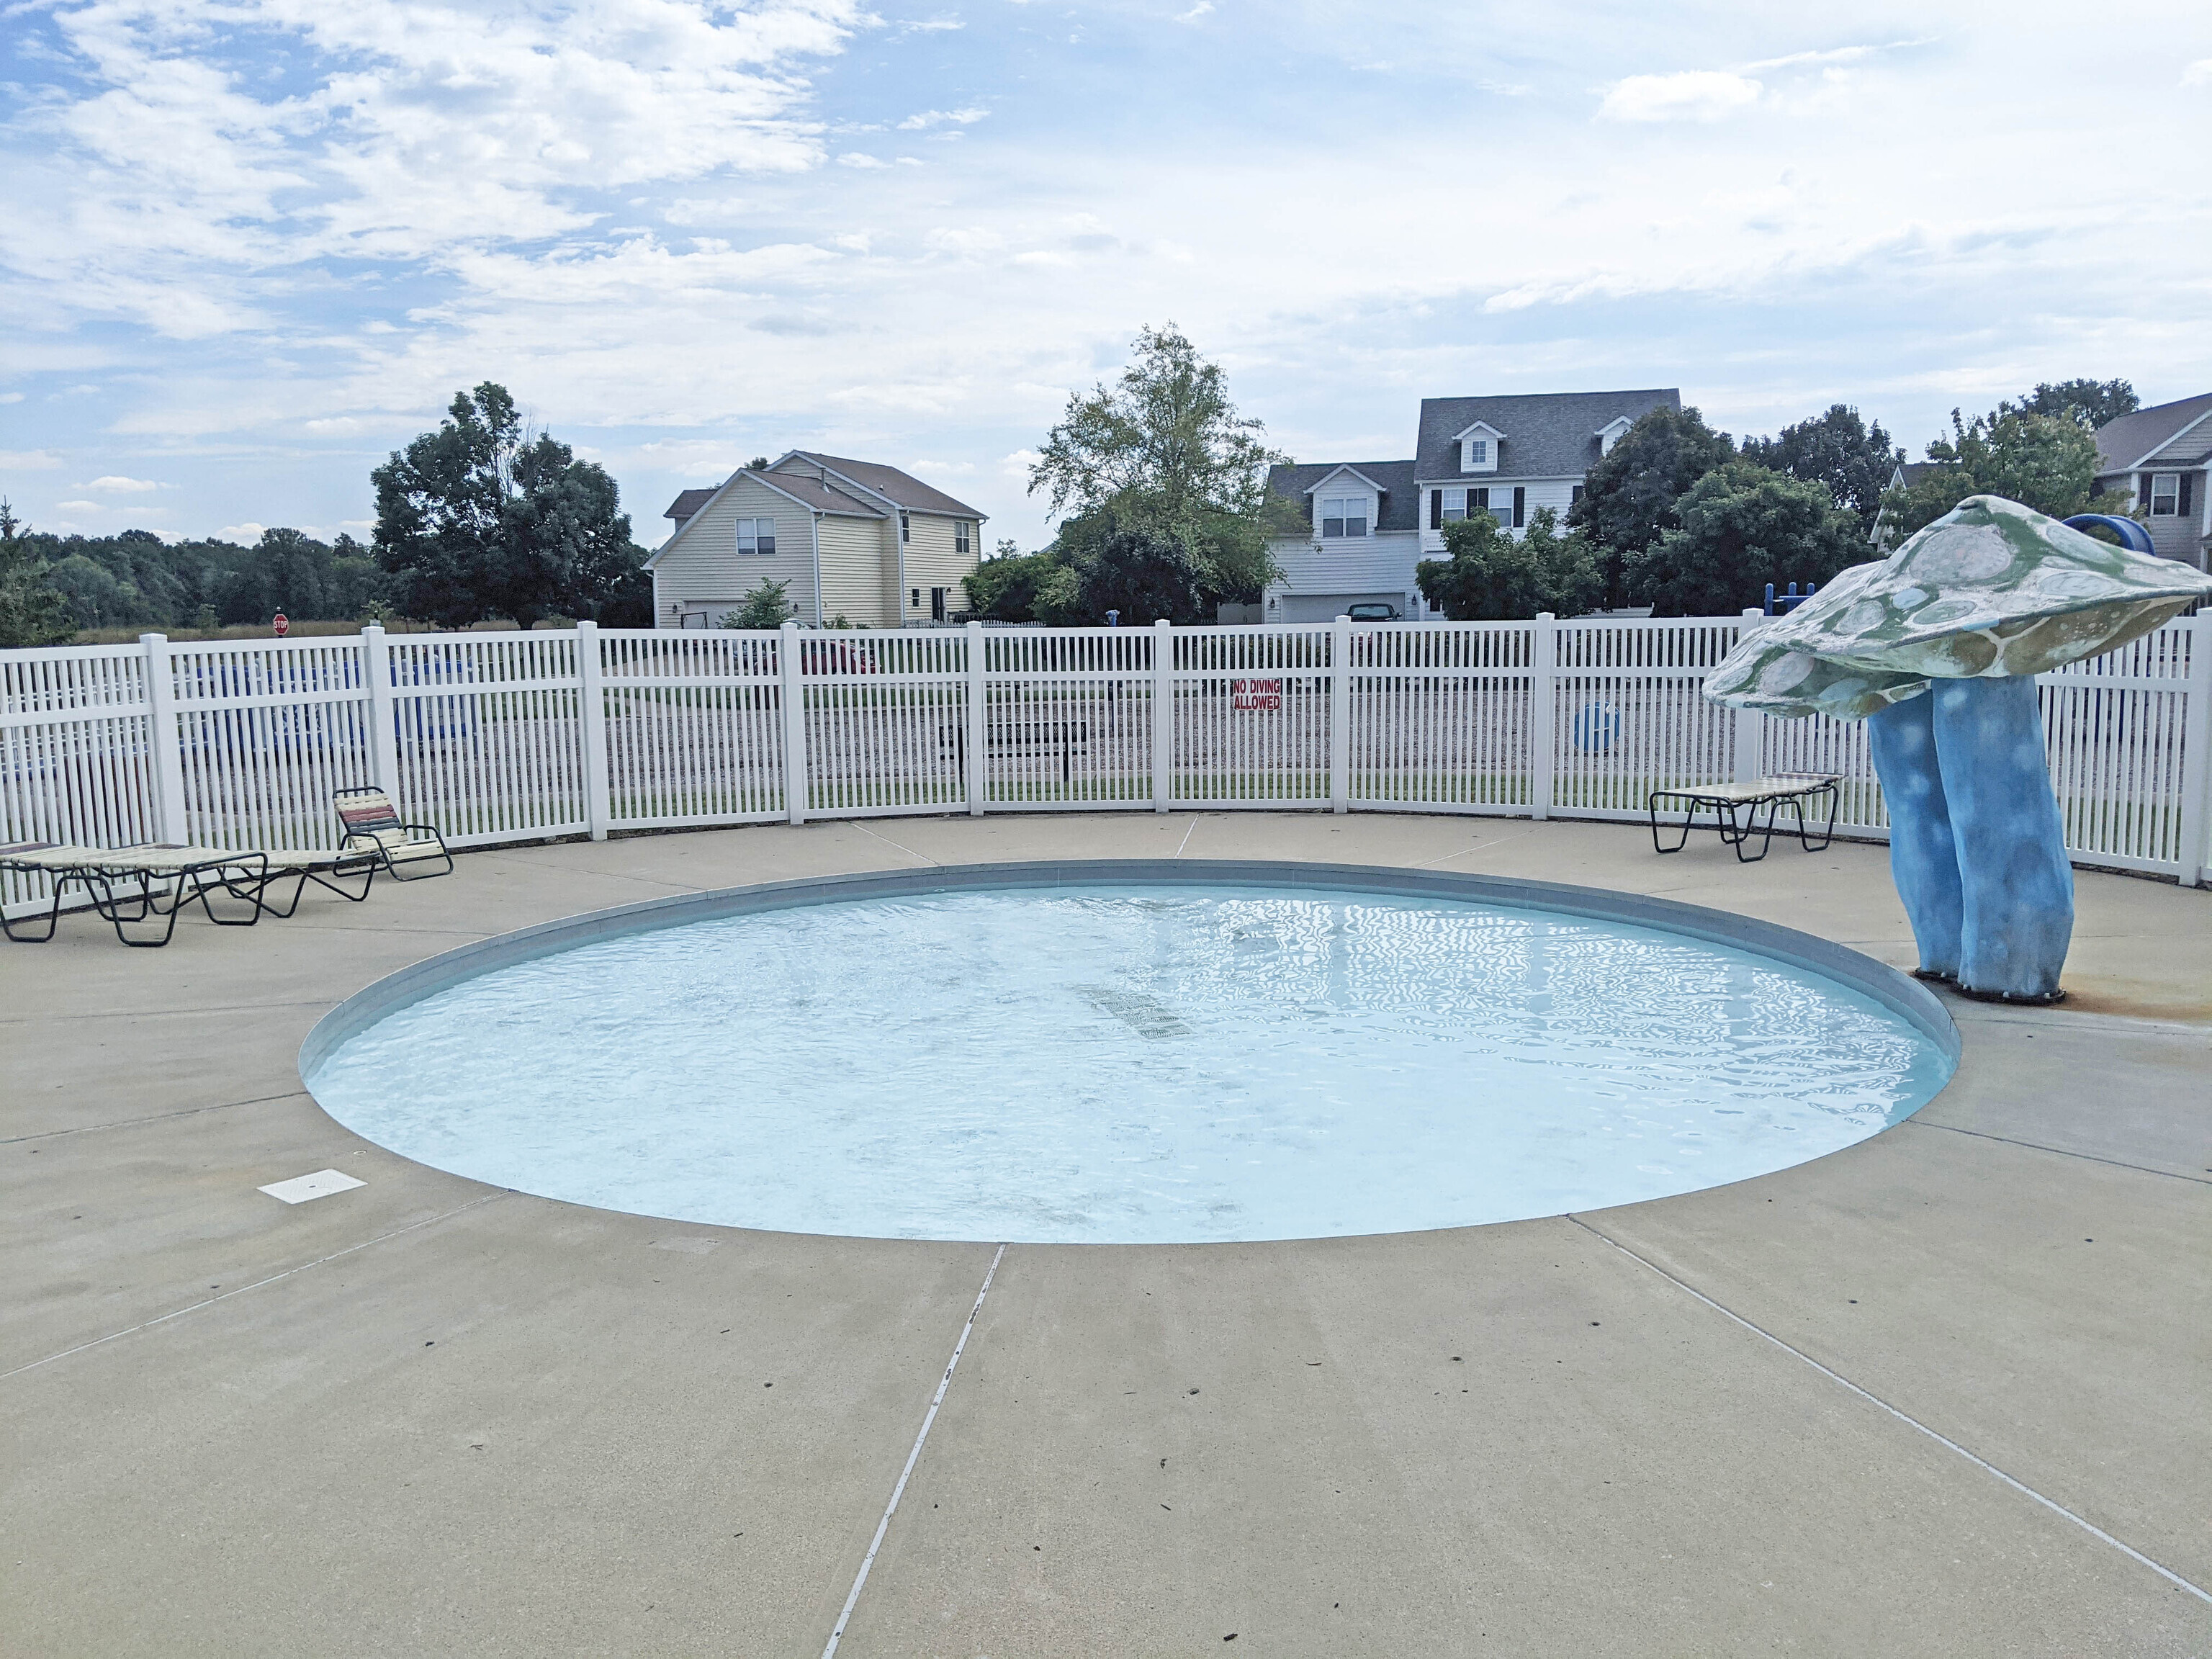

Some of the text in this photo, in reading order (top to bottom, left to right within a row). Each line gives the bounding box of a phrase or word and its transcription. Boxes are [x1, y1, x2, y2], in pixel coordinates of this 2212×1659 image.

[1233, 679, 1280, 693] NO DIVING
[1234, 695, 1280, 710] ALLOWED
